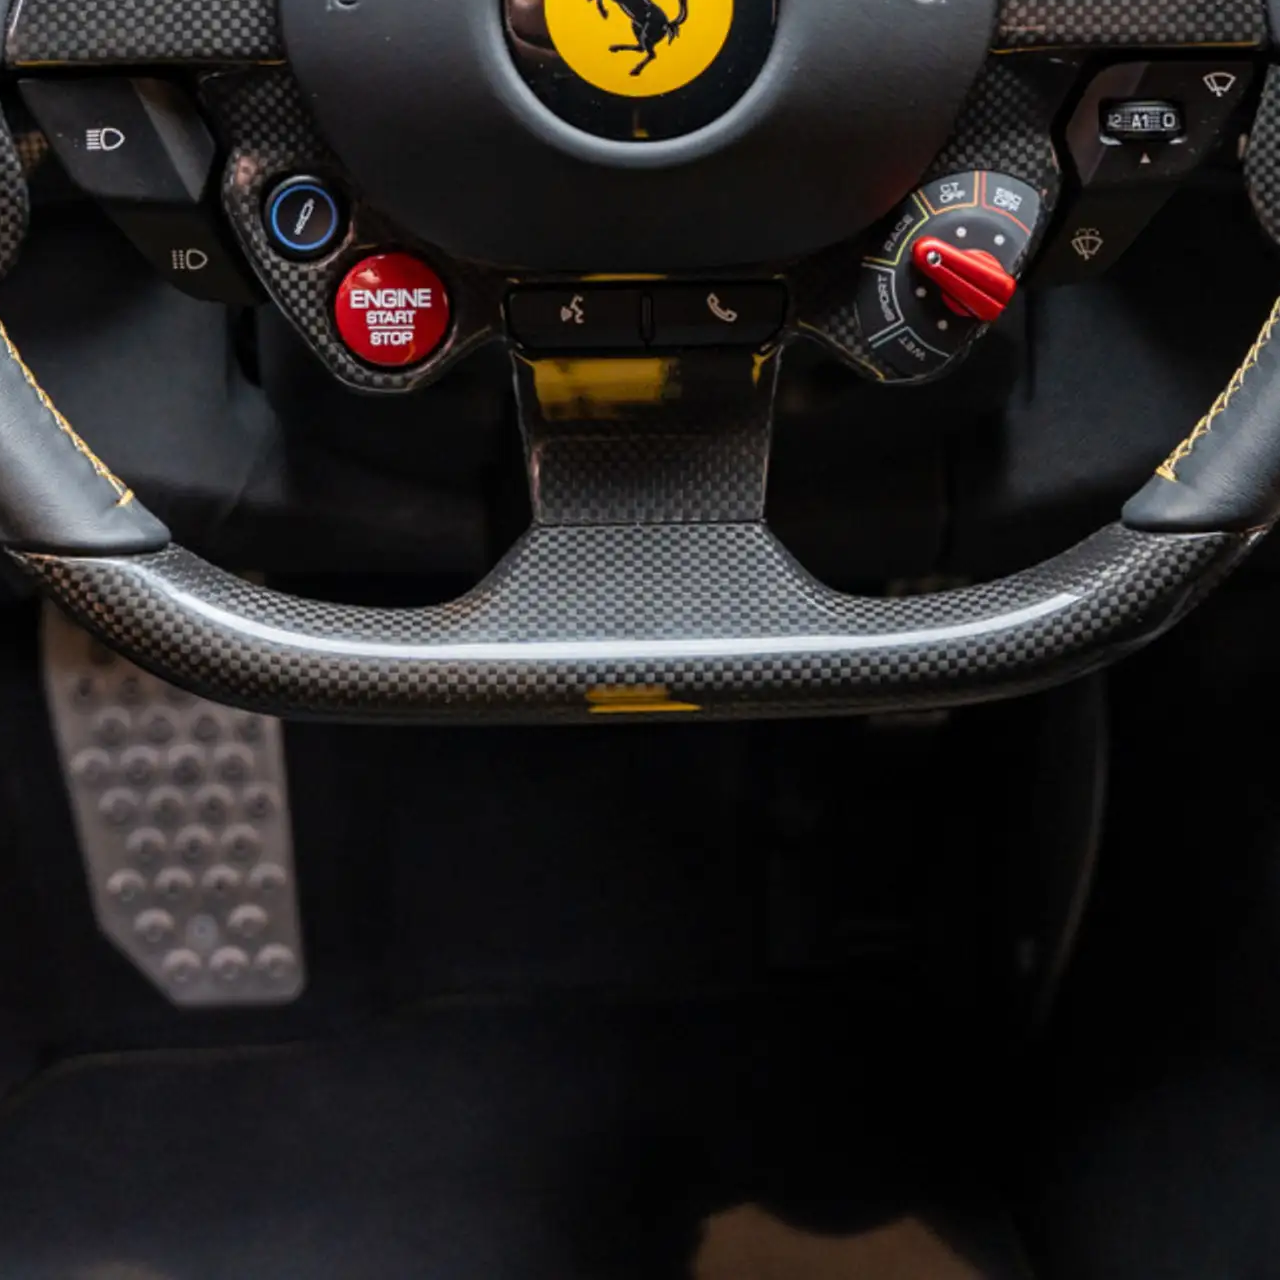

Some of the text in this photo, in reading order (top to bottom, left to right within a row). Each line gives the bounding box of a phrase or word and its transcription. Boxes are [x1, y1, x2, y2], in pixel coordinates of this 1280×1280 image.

[1131, 114, 1150, 129] A1
[939, 182, 960, 195] CT
[884, 214, 914, 252] RACE
[350, 288, 432, 309] ENGINE
[877, 274, 896, 322] SPORT
[366, 310, 416, 325] START
[370, 331, 414, 346] STOP
